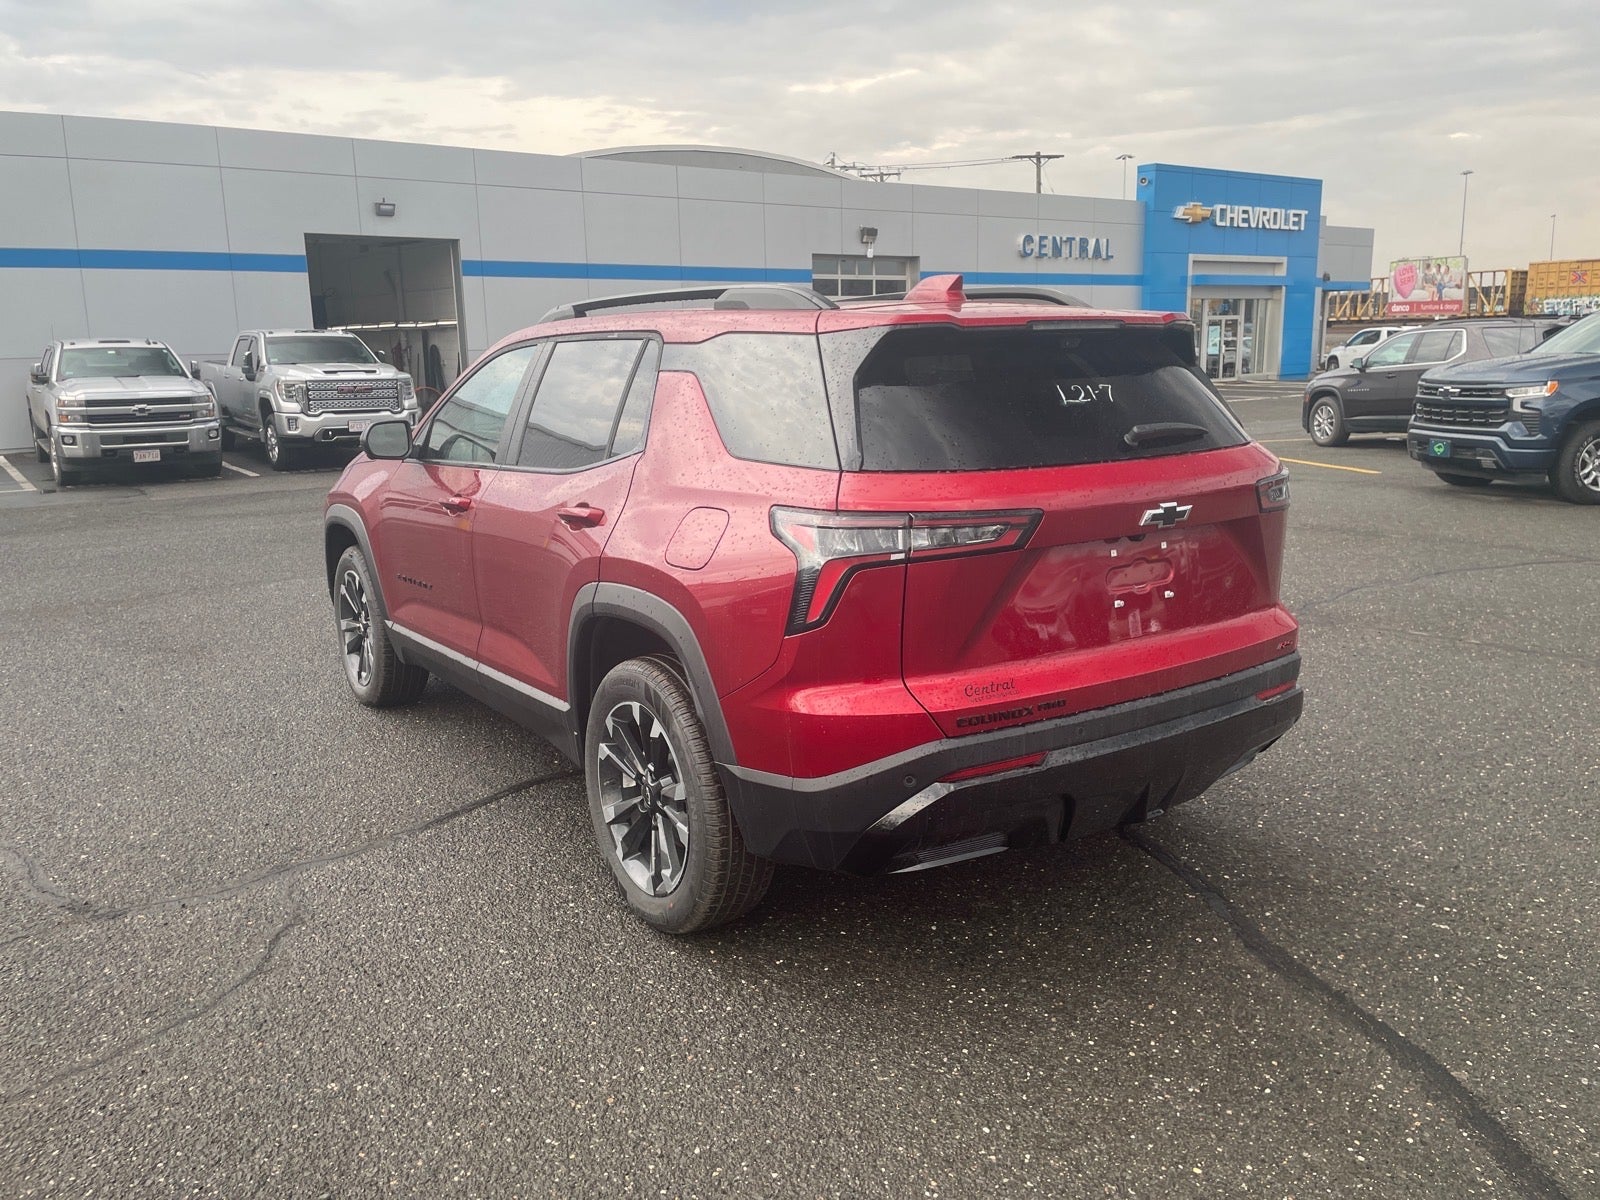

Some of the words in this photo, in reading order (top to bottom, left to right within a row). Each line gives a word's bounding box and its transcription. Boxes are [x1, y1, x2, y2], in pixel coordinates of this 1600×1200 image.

[1214, 204, 1309, 231] CHEVROLET
[1019, 234, 1114, 261] CENTRAL
[1391, 303, 1410, 312] danco
[964, 678, 1016, 698] Central
[956, 706, 1034, 728] EQUINOX
